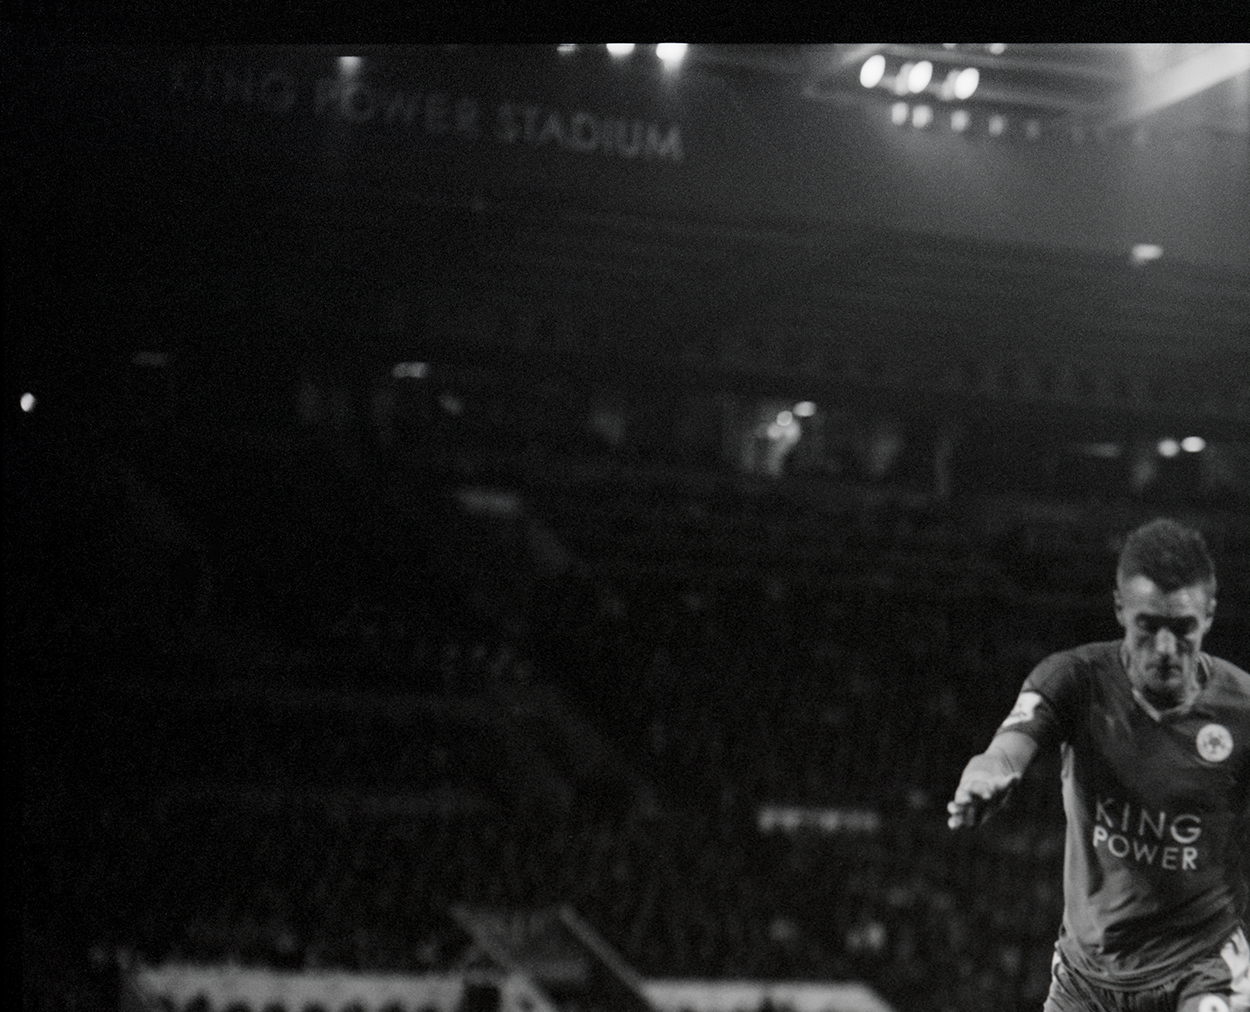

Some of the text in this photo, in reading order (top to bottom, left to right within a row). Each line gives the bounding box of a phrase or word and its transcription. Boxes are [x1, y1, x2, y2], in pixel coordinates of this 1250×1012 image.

[314, 76, 480, 138] POWER
[493, 102, 684, 163] STADIUM
[1095, 795, 1203, 845] KING
[1092, 824, 1199, 872] POWER
